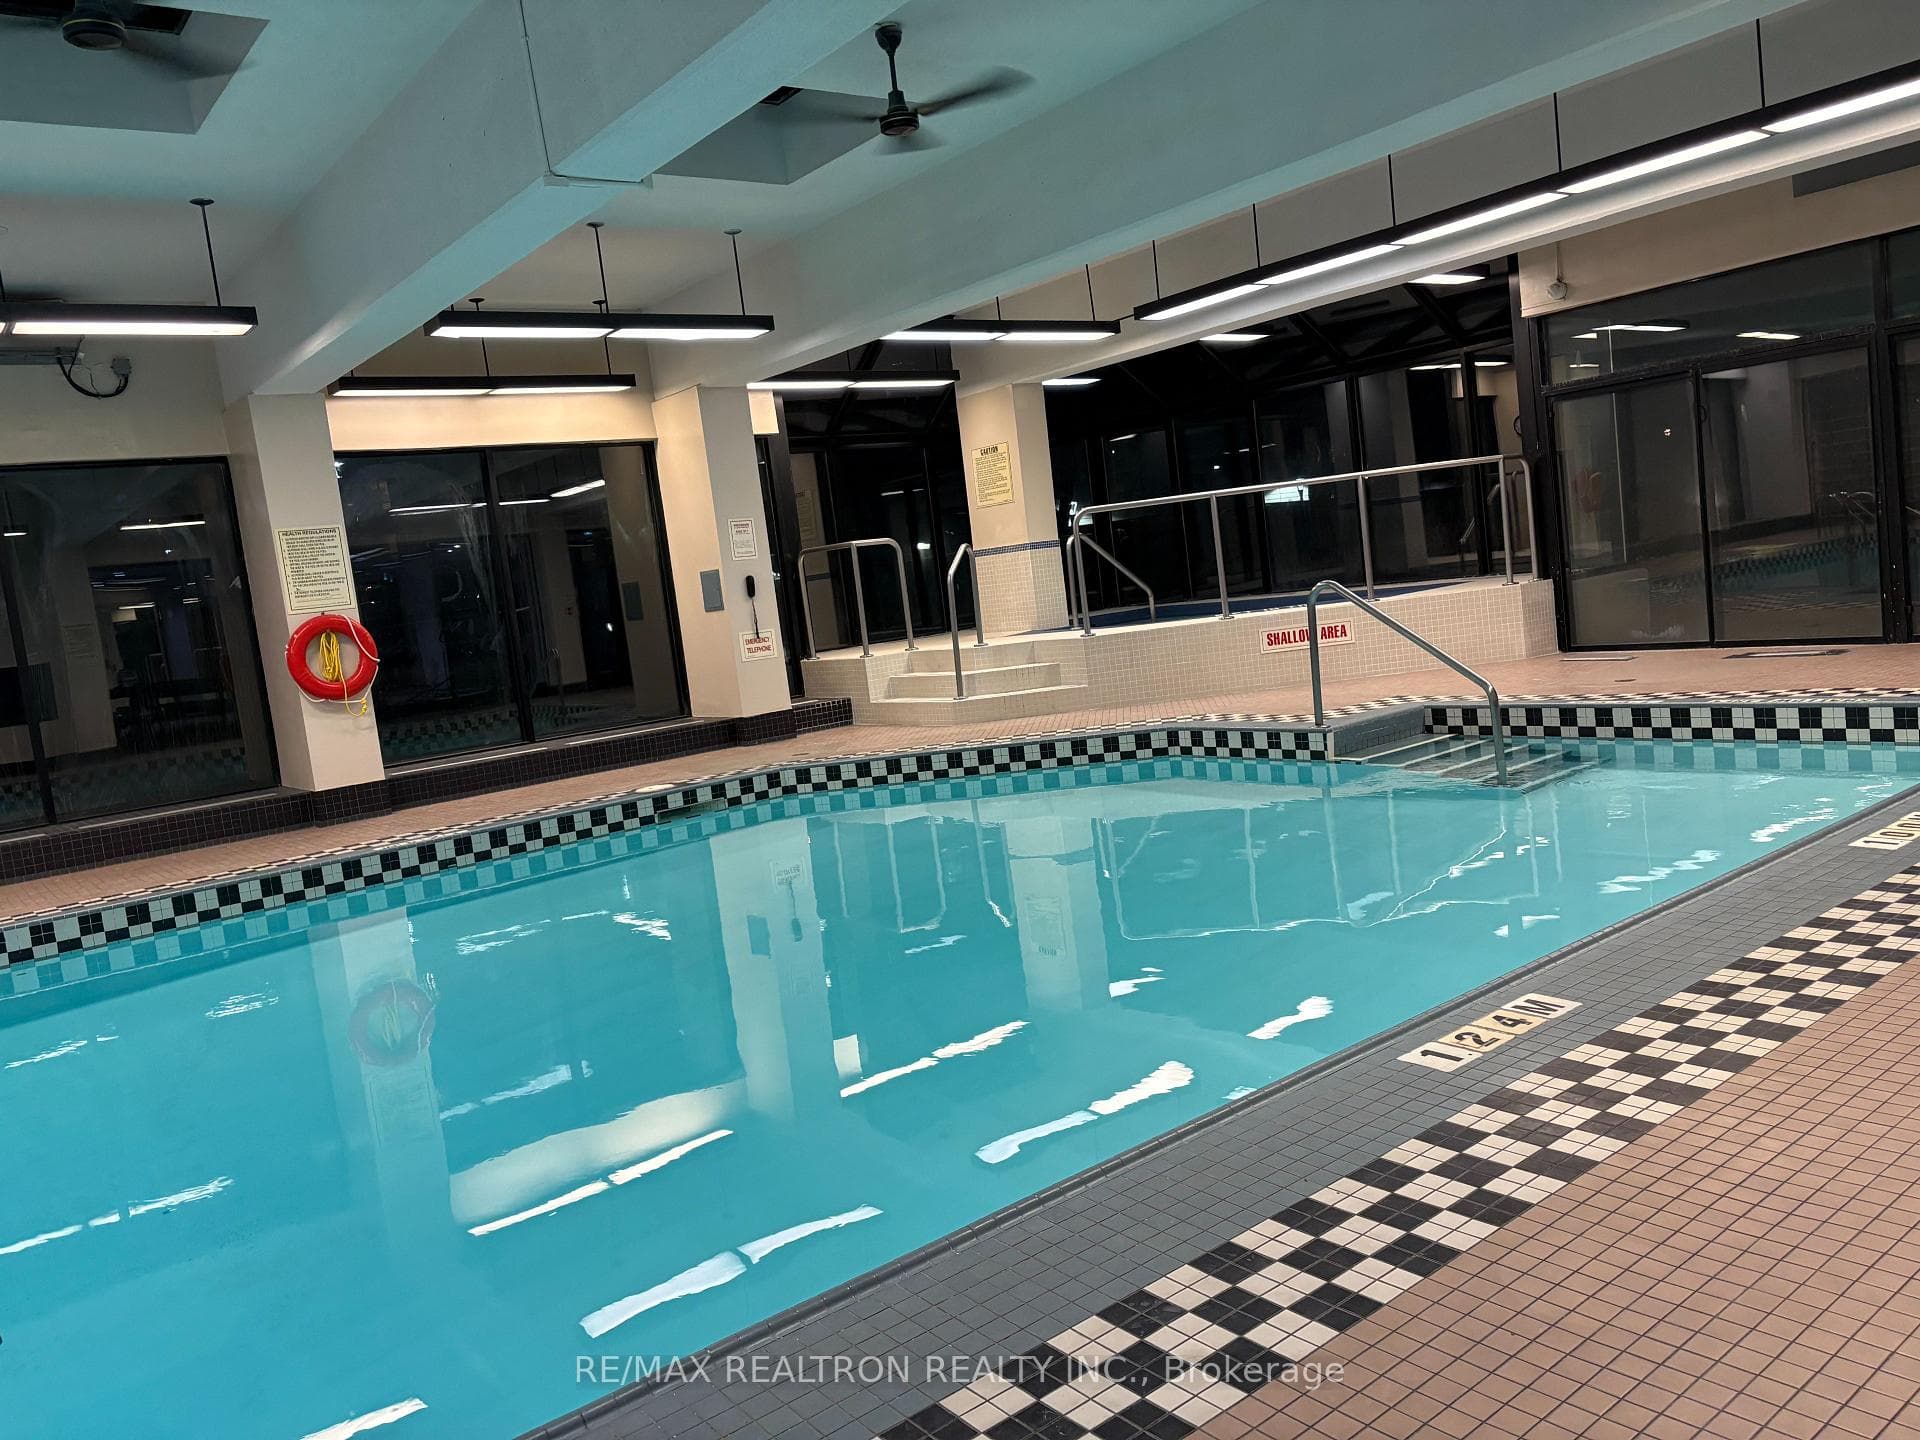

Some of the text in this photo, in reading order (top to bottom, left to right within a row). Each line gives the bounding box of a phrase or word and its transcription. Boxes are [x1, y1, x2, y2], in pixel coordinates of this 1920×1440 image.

[303, 528, 337, 536] REGULATIONS
[1320, 624, 1348, 640] AREA
[747, 645, 772, 654] TELEPHONE
